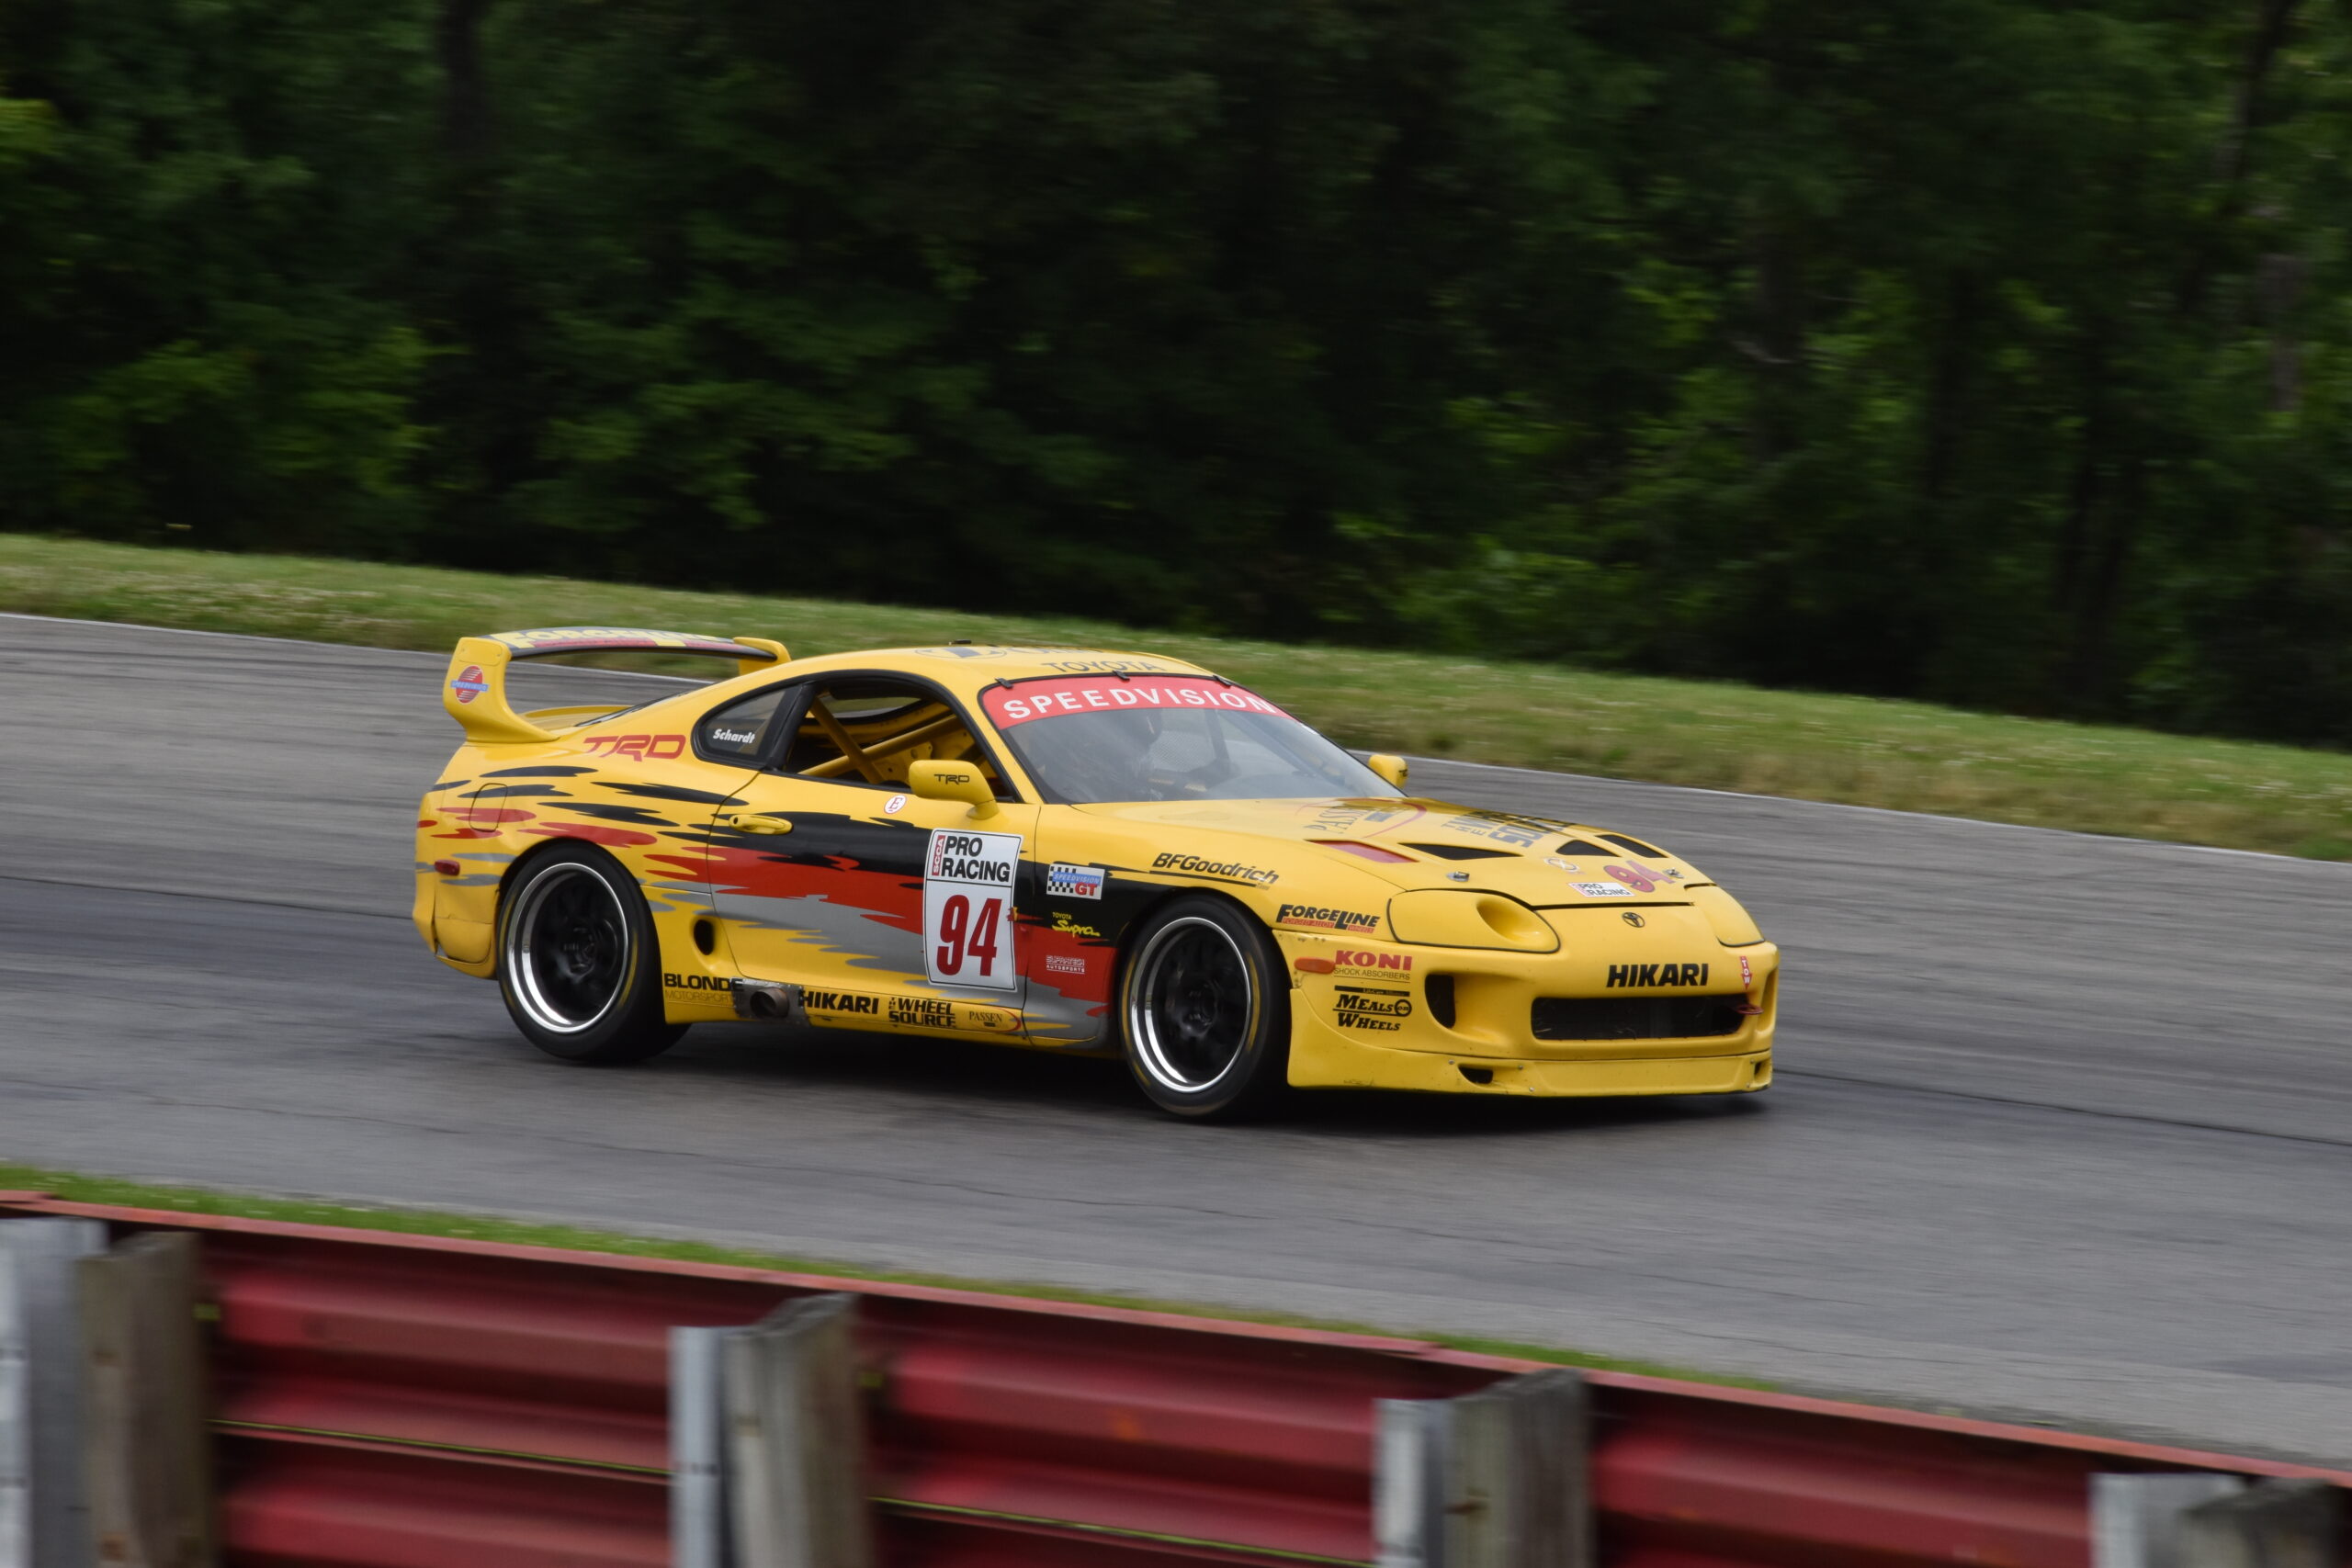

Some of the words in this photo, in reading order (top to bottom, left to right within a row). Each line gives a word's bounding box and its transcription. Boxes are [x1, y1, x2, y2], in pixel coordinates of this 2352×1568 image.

[1041, 660, 1165, 672] TOYOTA
[1003, 687, 1277, 719] SPEEDVISION
[712, 728, 755, 744] Schardt
[583, 735, 686, 761] TRD
[933, 773, 970, 784] TRD
[933, 837, 944, 874] SCCA
[944, 835, 983, 857] PRO
[941, 857, 1011, 883] RACING
[1152, 852, 1280, 885] BFGoodrich
[1603, 860, 1676, 893] 94
[1053, 874, 1102, 885] SPEEDVISION
[1075, 882, 1098, 897] GT
[1588, 888, 1632, 897] RACING
[1052, 911, 1072, 920] TOYOTA
[1275, 904, 1381, 931] FORGELINE
[936, 894, 1003, 976] 94
[1051, 919, 1101, 938] Supra
[1335, 950, 1412, 971] KONI
[1334, 967, 1360, 976] SHOCK
[1361, 970, 1410, 981] ABSORBERS
[1606, 963, 1709, 988] HIKARI
[1741, 959, 1750, 984] TOW
[663, 973, 744, 992] BLONDE
[797, 988, 879, 1014] HIKARI
[898, 998, 956, 1016] WHEEL
[1336, 994, 1394, 1013] MEALS
[888, 1010, 956, 1028] SOURCE
[969, 1010, 1003, 1022] PASSEN
[1338, 1012, 1401, 1032] WHEELS
